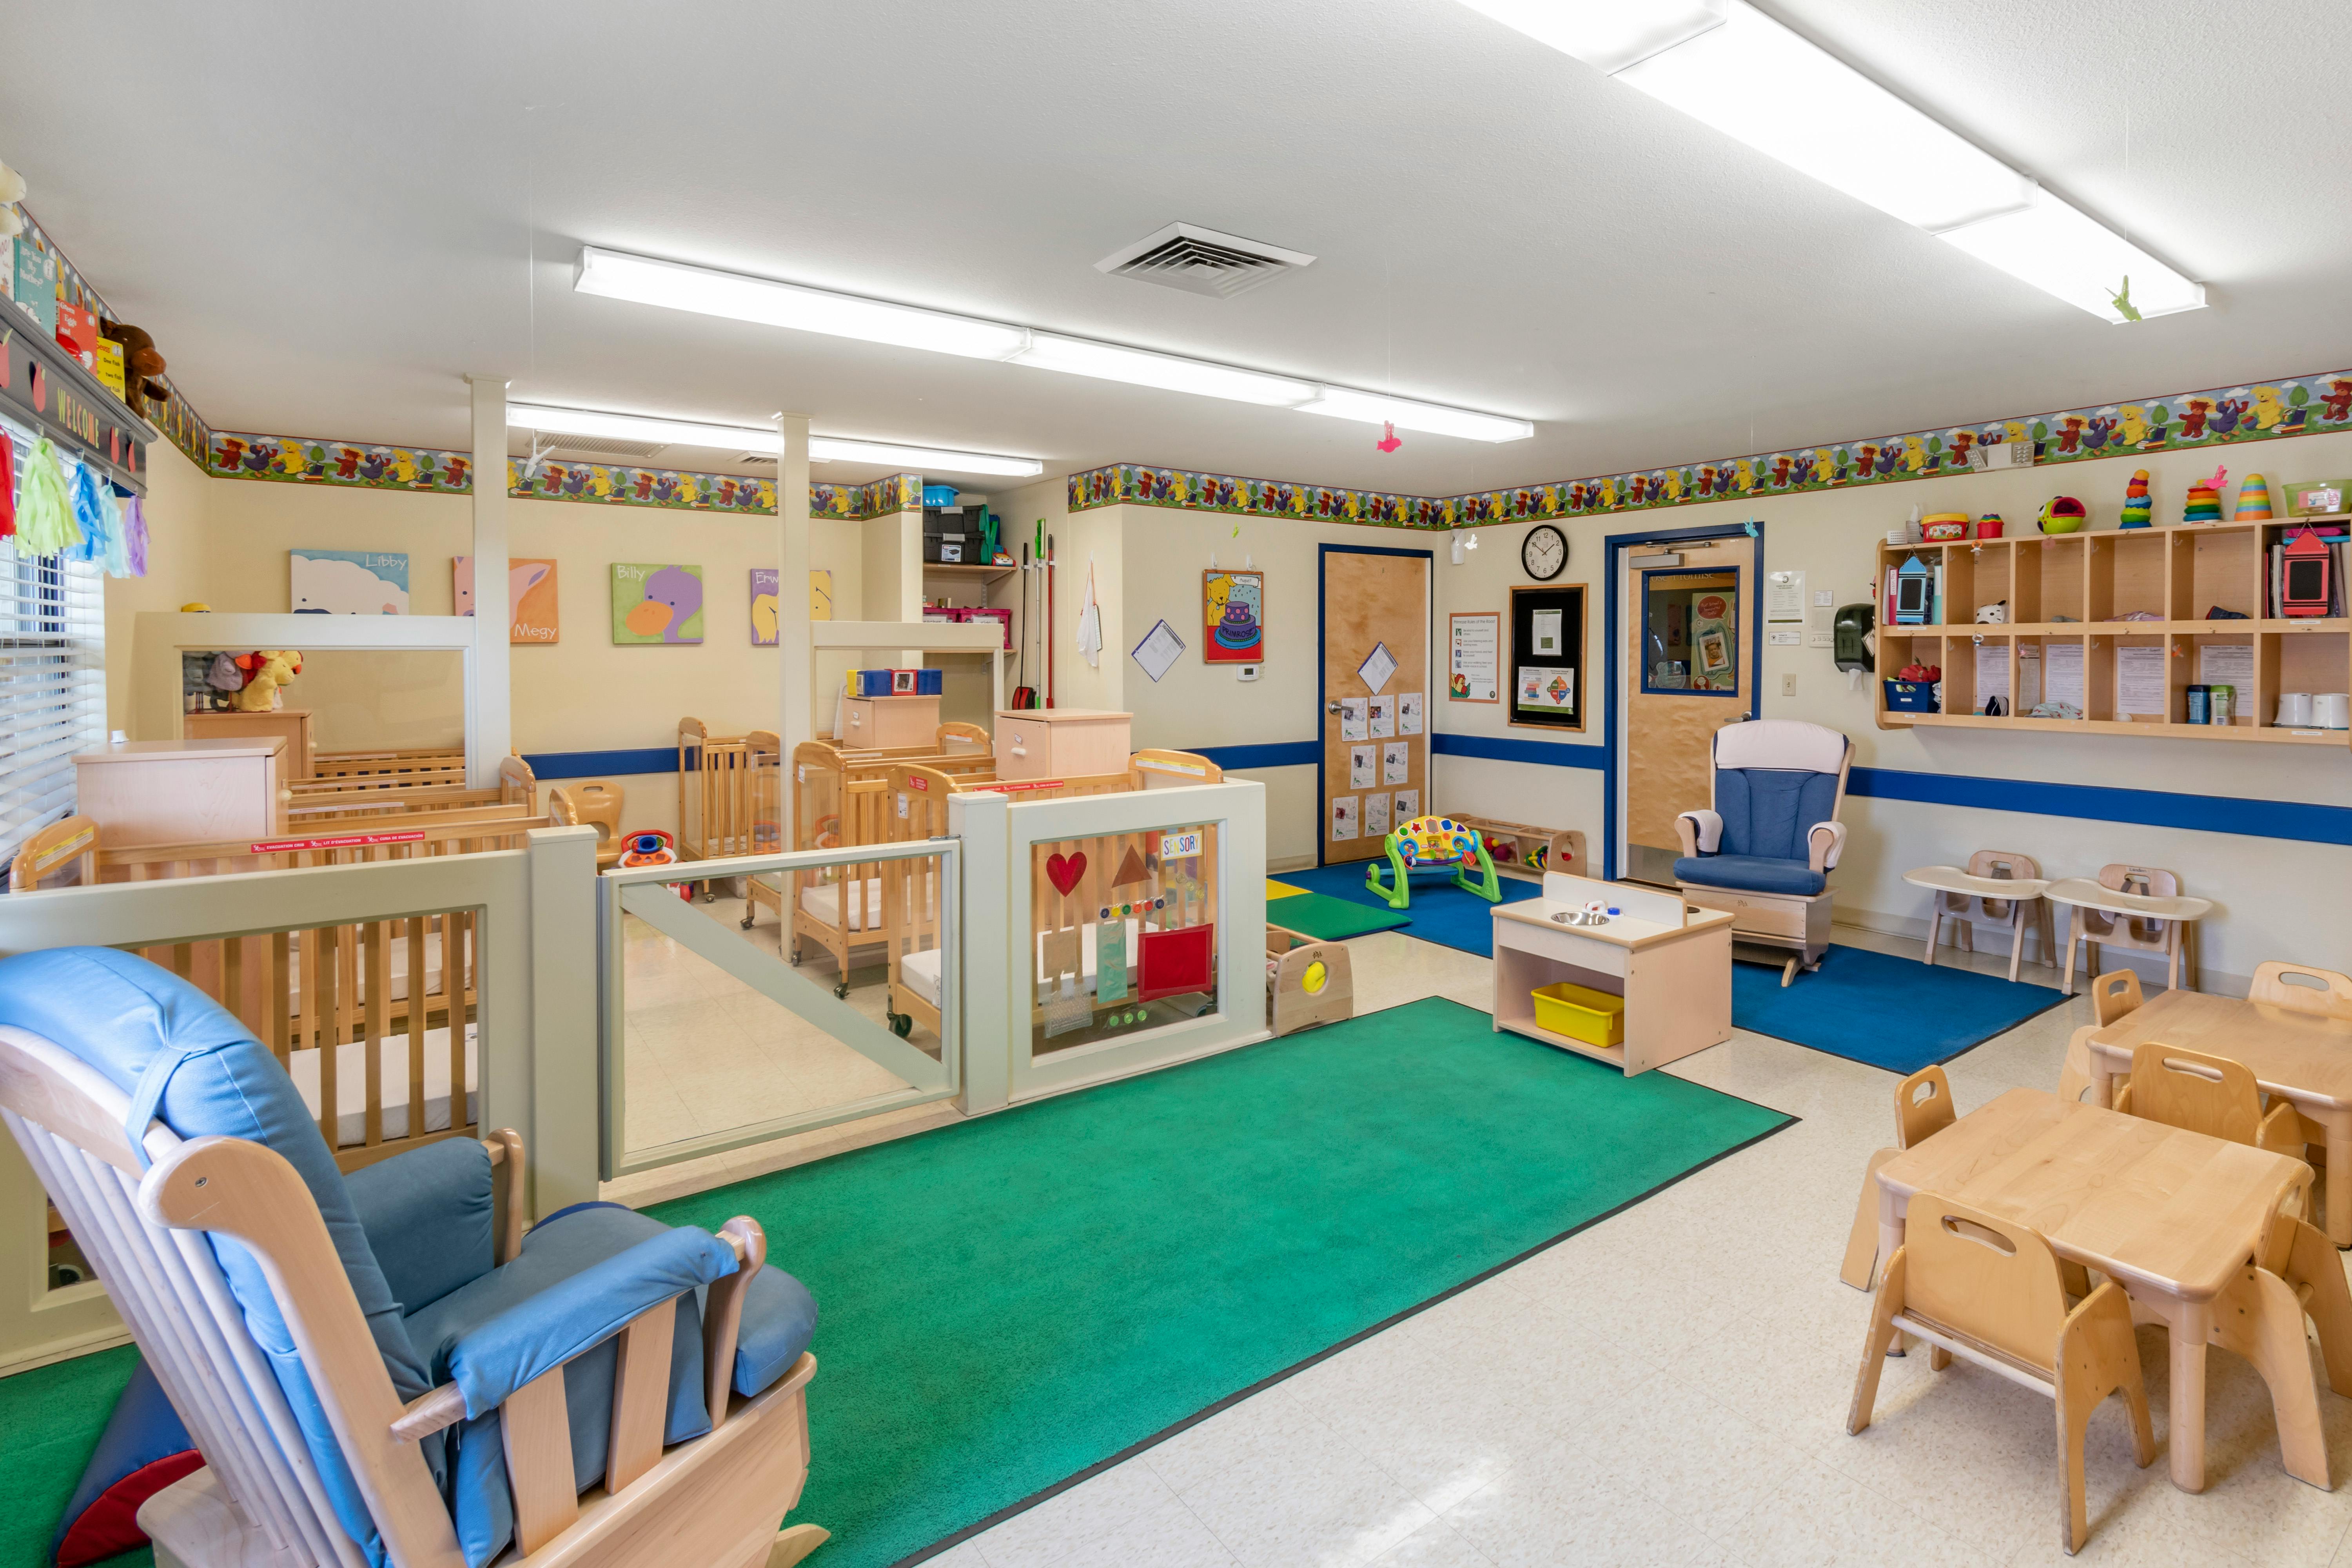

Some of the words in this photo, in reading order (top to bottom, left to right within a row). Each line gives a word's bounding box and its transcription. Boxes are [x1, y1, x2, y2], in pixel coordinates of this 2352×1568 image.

[31, 251, 41, 263] You
[27, 260, 37, 274] My
[20, 268, 43, 289] Mother?
[60, 301, 75, 314] Green
[64, 314, 77, 328] Eggs
[61, 327, 71, 335] and
[58, 387, 100, 449] WELCOME
[366, 554, 407, 571] Libby
[617, 565, 646, 582] Billy
[755, 572, 779, 584] Erw
[514, 623, 557, 639] Megy
[1222, 626, 1253, 638] PRIMROSE
[1164, 835, 1199, 855] SENSORY
